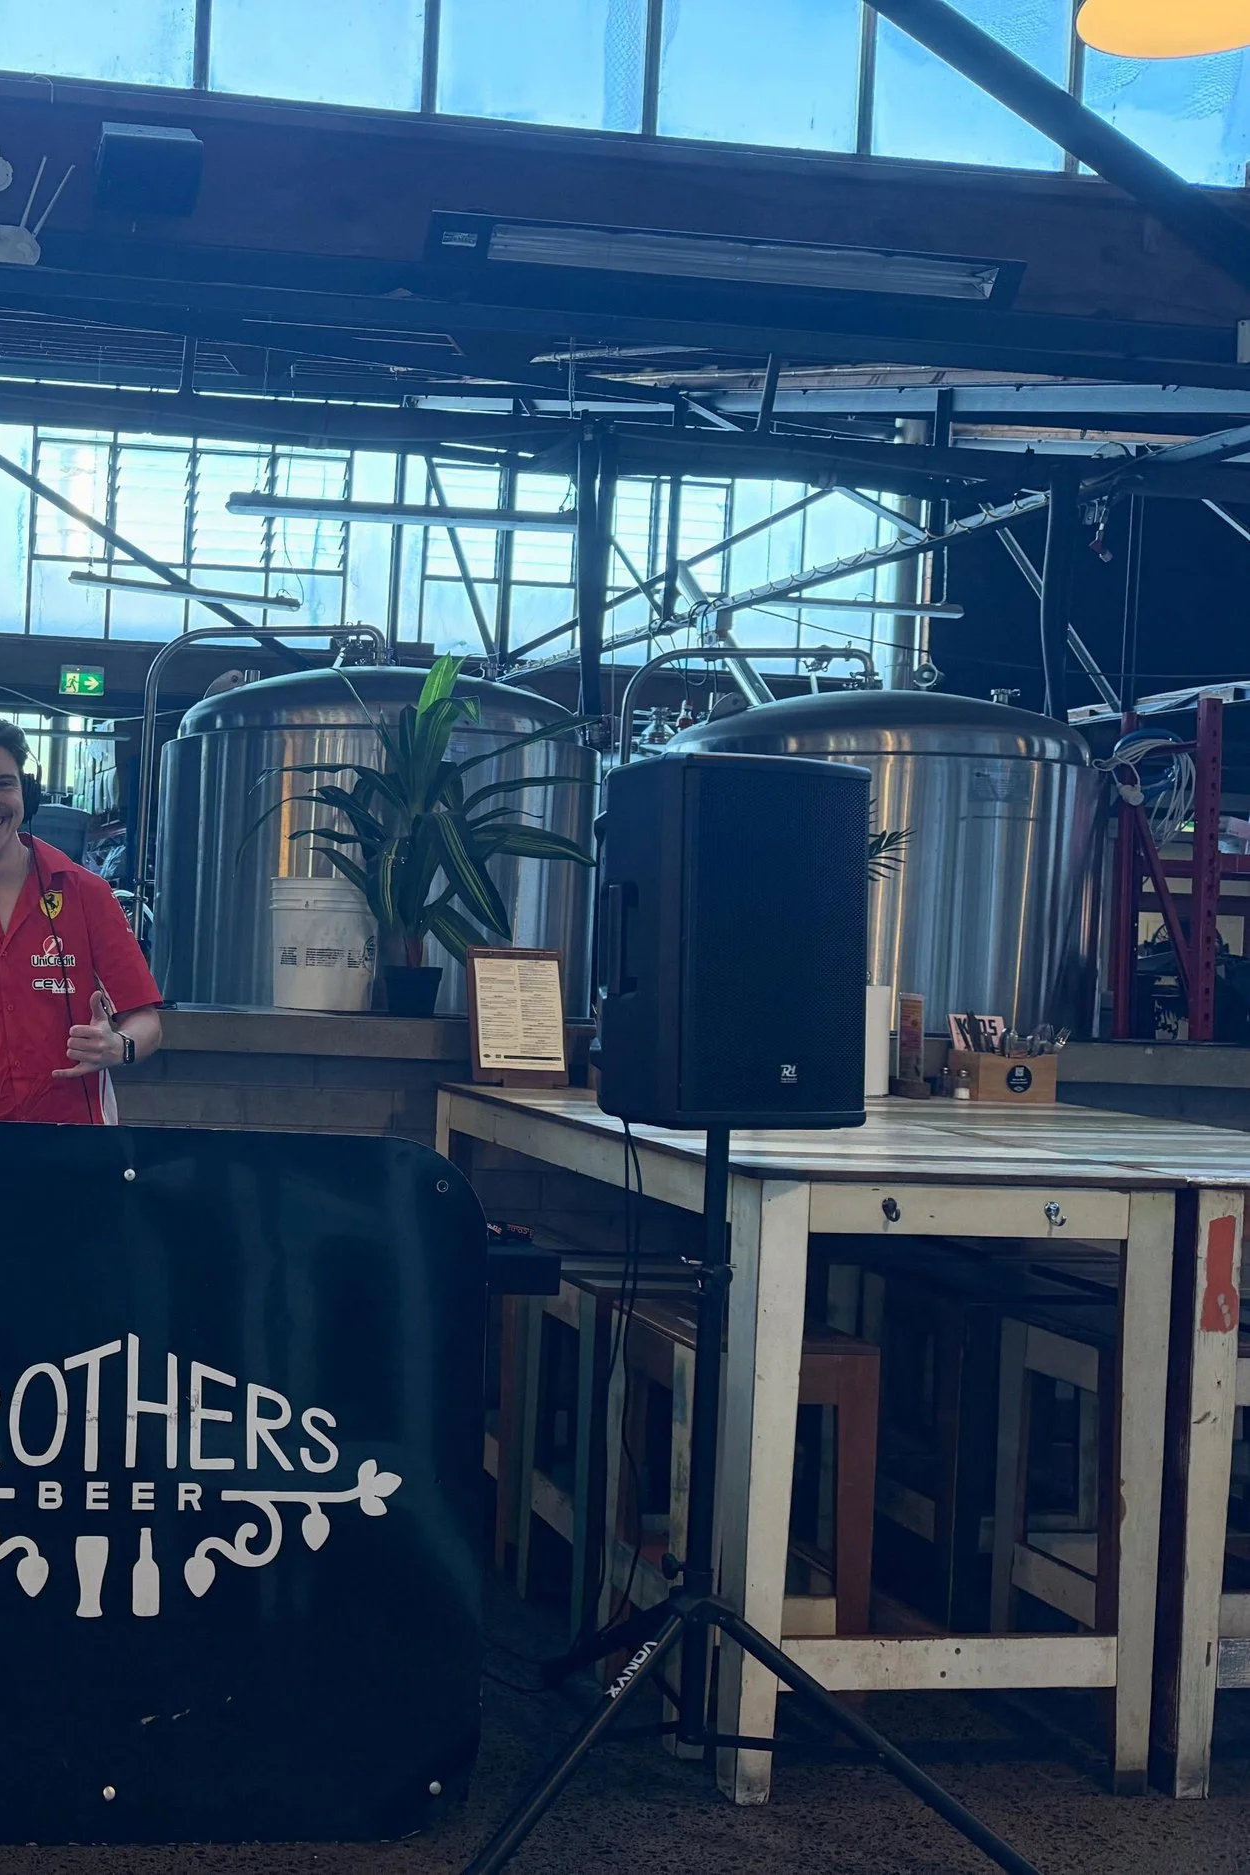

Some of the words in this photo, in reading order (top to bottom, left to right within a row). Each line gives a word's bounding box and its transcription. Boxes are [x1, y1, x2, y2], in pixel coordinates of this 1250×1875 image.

[960, 1016, 998, 1037] KDS
[37, 1480, 203, 1512] BEER
[605, 1641, 658, 1699] VONYX
